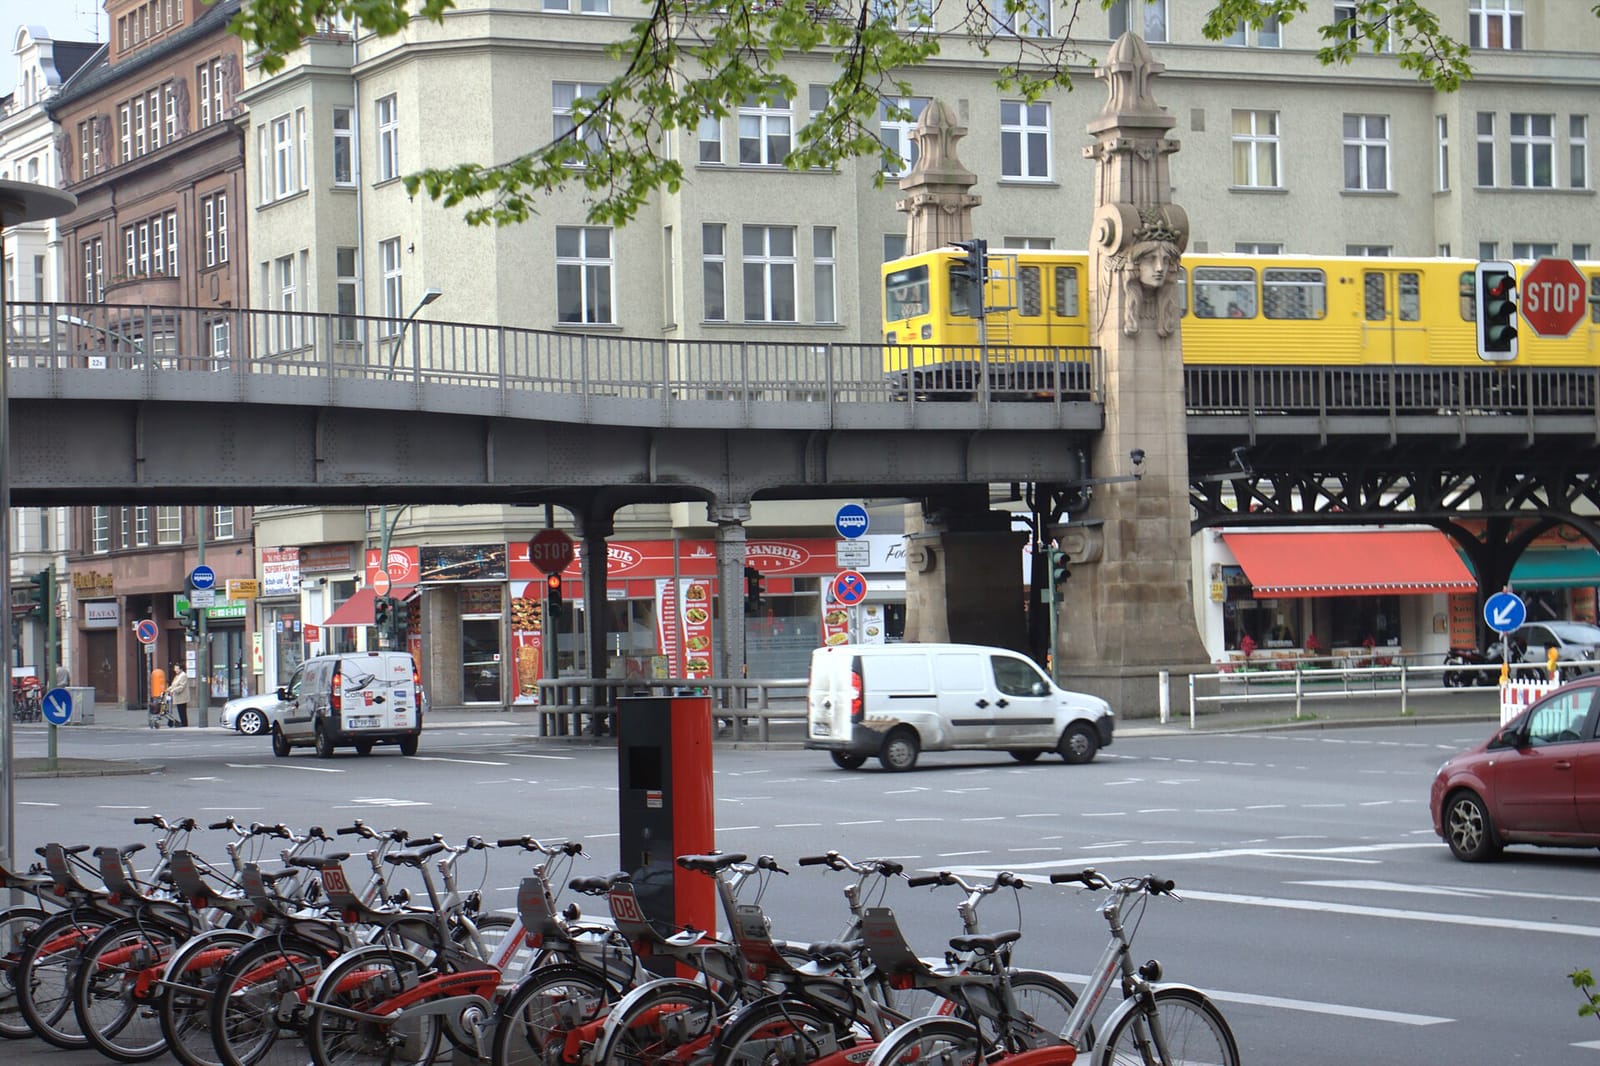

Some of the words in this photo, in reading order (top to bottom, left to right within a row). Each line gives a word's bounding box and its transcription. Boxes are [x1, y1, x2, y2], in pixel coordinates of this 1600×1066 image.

[1527, 281, 1580, 313] STOP
[533, 542, 569, 560] STOP
[323, 870, 346, 891] DB
[611, 895, 638, 919] DB
